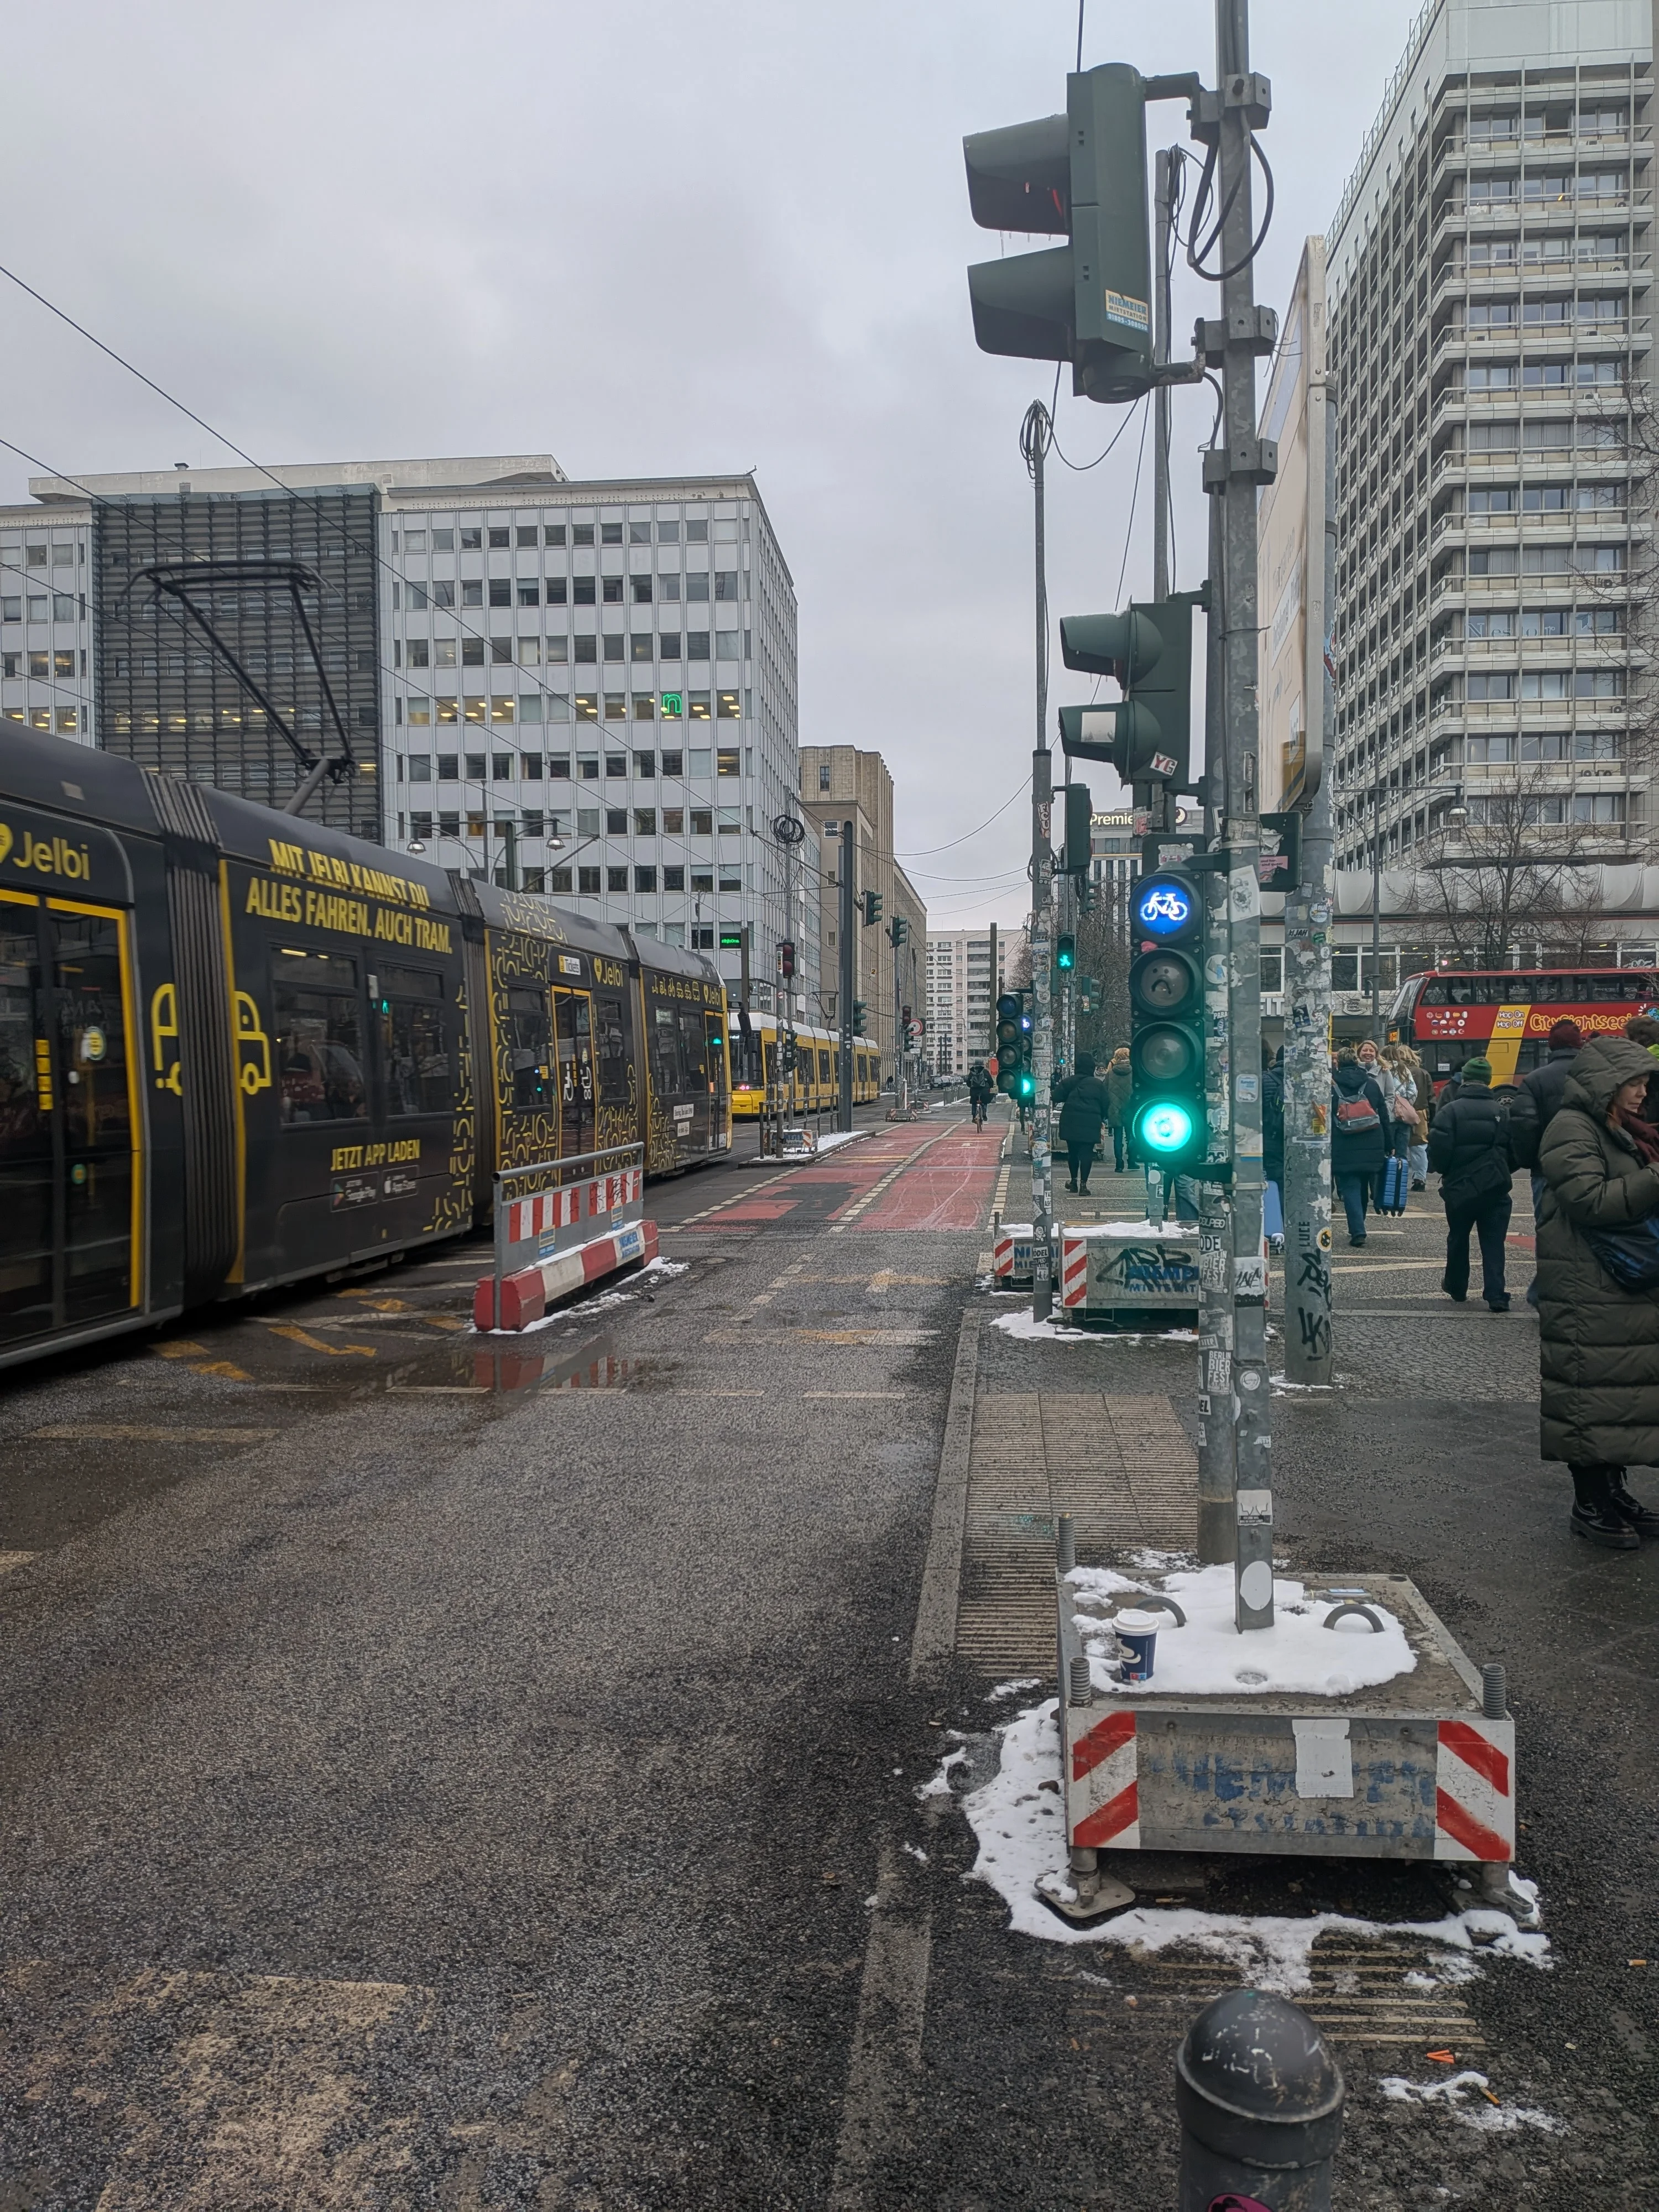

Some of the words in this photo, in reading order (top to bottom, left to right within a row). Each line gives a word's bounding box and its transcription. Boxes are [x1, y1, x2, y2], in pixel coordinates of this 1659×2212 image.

[1108, 295, 1146, 315] NIEMEIER
[1109, 305, 1146, 321] MIETSTATION
[13, 831, 90, 880] Jelbi
[268, 838, 304, 878] MIT
[349, 863, 408, 906] KANNST
[407, 880, 430, 911] DU
[246, 877, 302, 923] ALLES
[306, 890, 372, 936] FAHREN.
[374, 907, 413, 945] AUCH
[414, 917, 453, 954] TRAM.
[603, 961, 623, 987] Jelbi
[708, 987, 721, 1005] Jelbi
[1514, 1009, 1525, 1018] On
[1496, 1020, 1511, 1029] Hop
[331, 1146, 363, 1171] JETZT
[364, 1144, 385, 1166] APP
[388, 1139, 420, 1162] LADEN
[1298, 1221, 1310, 1247] LUCE
[1203, 1257, 1225, 1271] BIER
[1202, 1267, 1225, 1282] FEST
[1209, 1350, 1232, 1360] BERLIN
[1208, 1359, 1231, 1374] BIER
[1207, 1371, 1230, 1383] FEST
